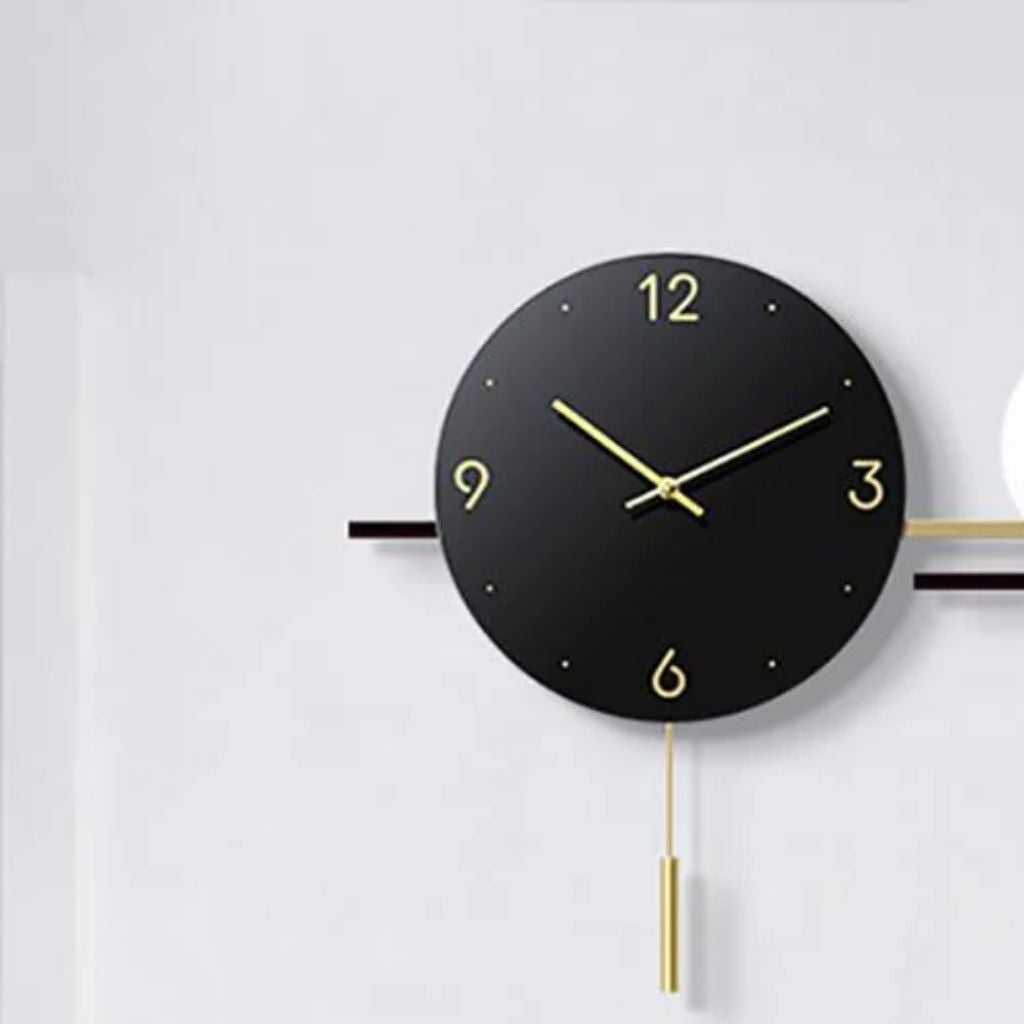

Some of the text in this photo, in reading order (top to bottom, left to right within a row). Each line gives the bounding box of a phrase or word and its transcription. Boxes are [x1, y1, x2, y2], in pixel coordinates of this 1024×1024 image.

[638, 272, 700, 322] 12
[453, 459, 490, 511] 9
[848, 459, 885, 511] 3
[652, 648, 687, 699] 6
